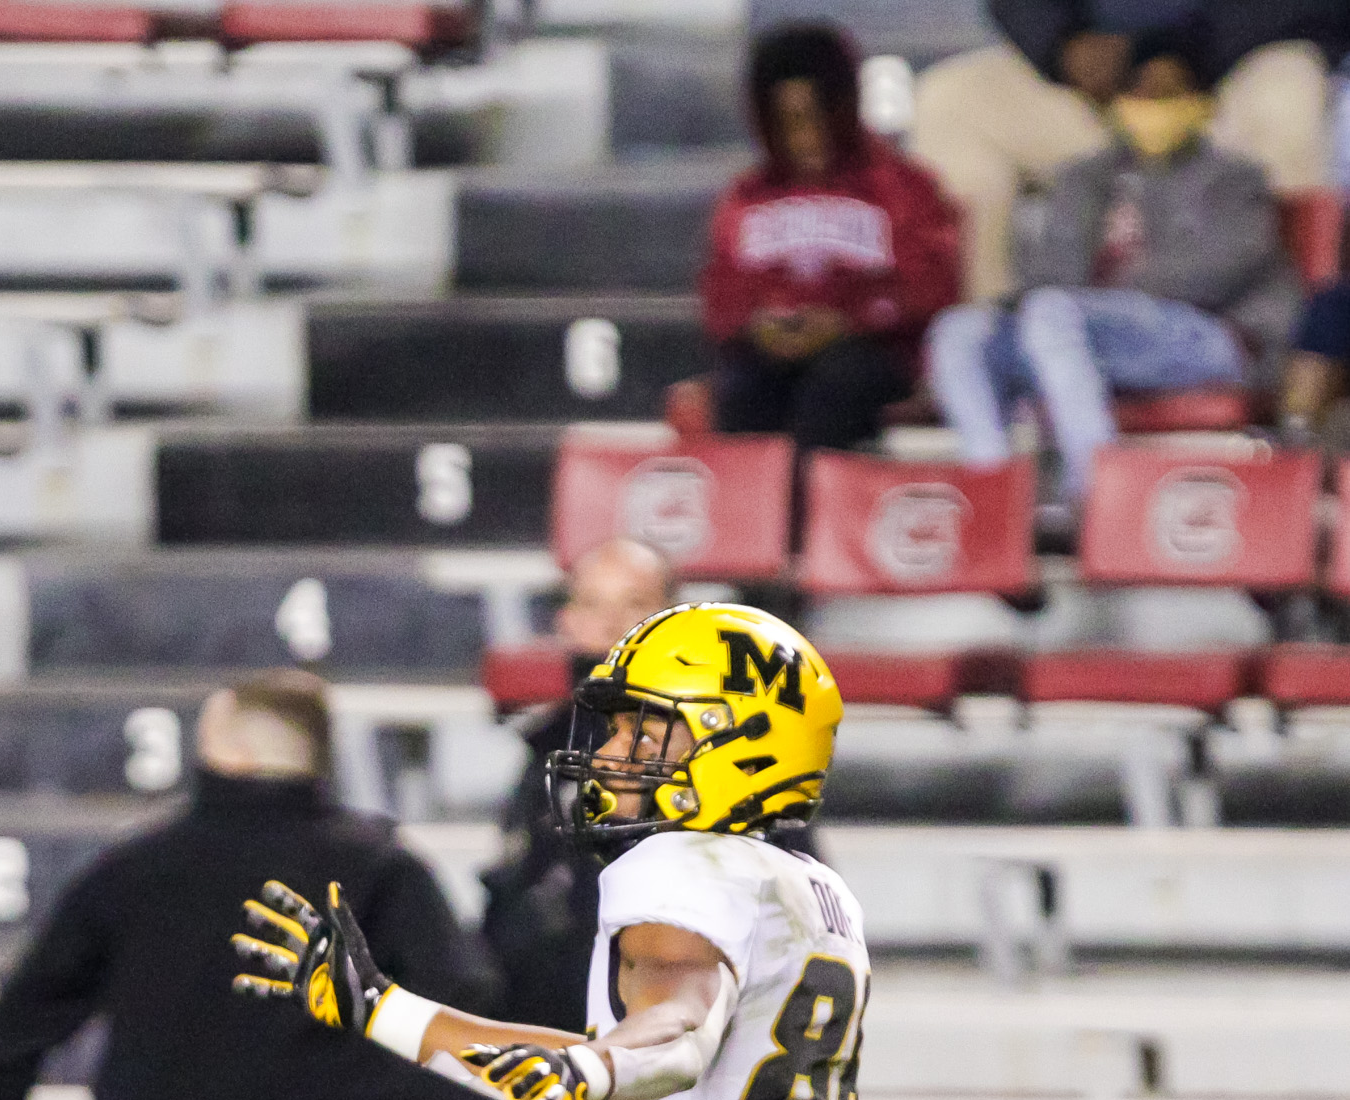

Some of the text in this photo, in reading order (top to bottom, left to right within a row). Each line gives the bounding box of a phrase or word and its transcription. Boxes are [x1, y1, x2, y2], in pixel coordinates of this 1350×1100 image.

[563, 317, 622, 397] 6
[415, 441, 474, 523] 5
[274, 577, 332, 659] 4
[716, 628, 806, 715] M
[123, 706, 181, 788] 3
